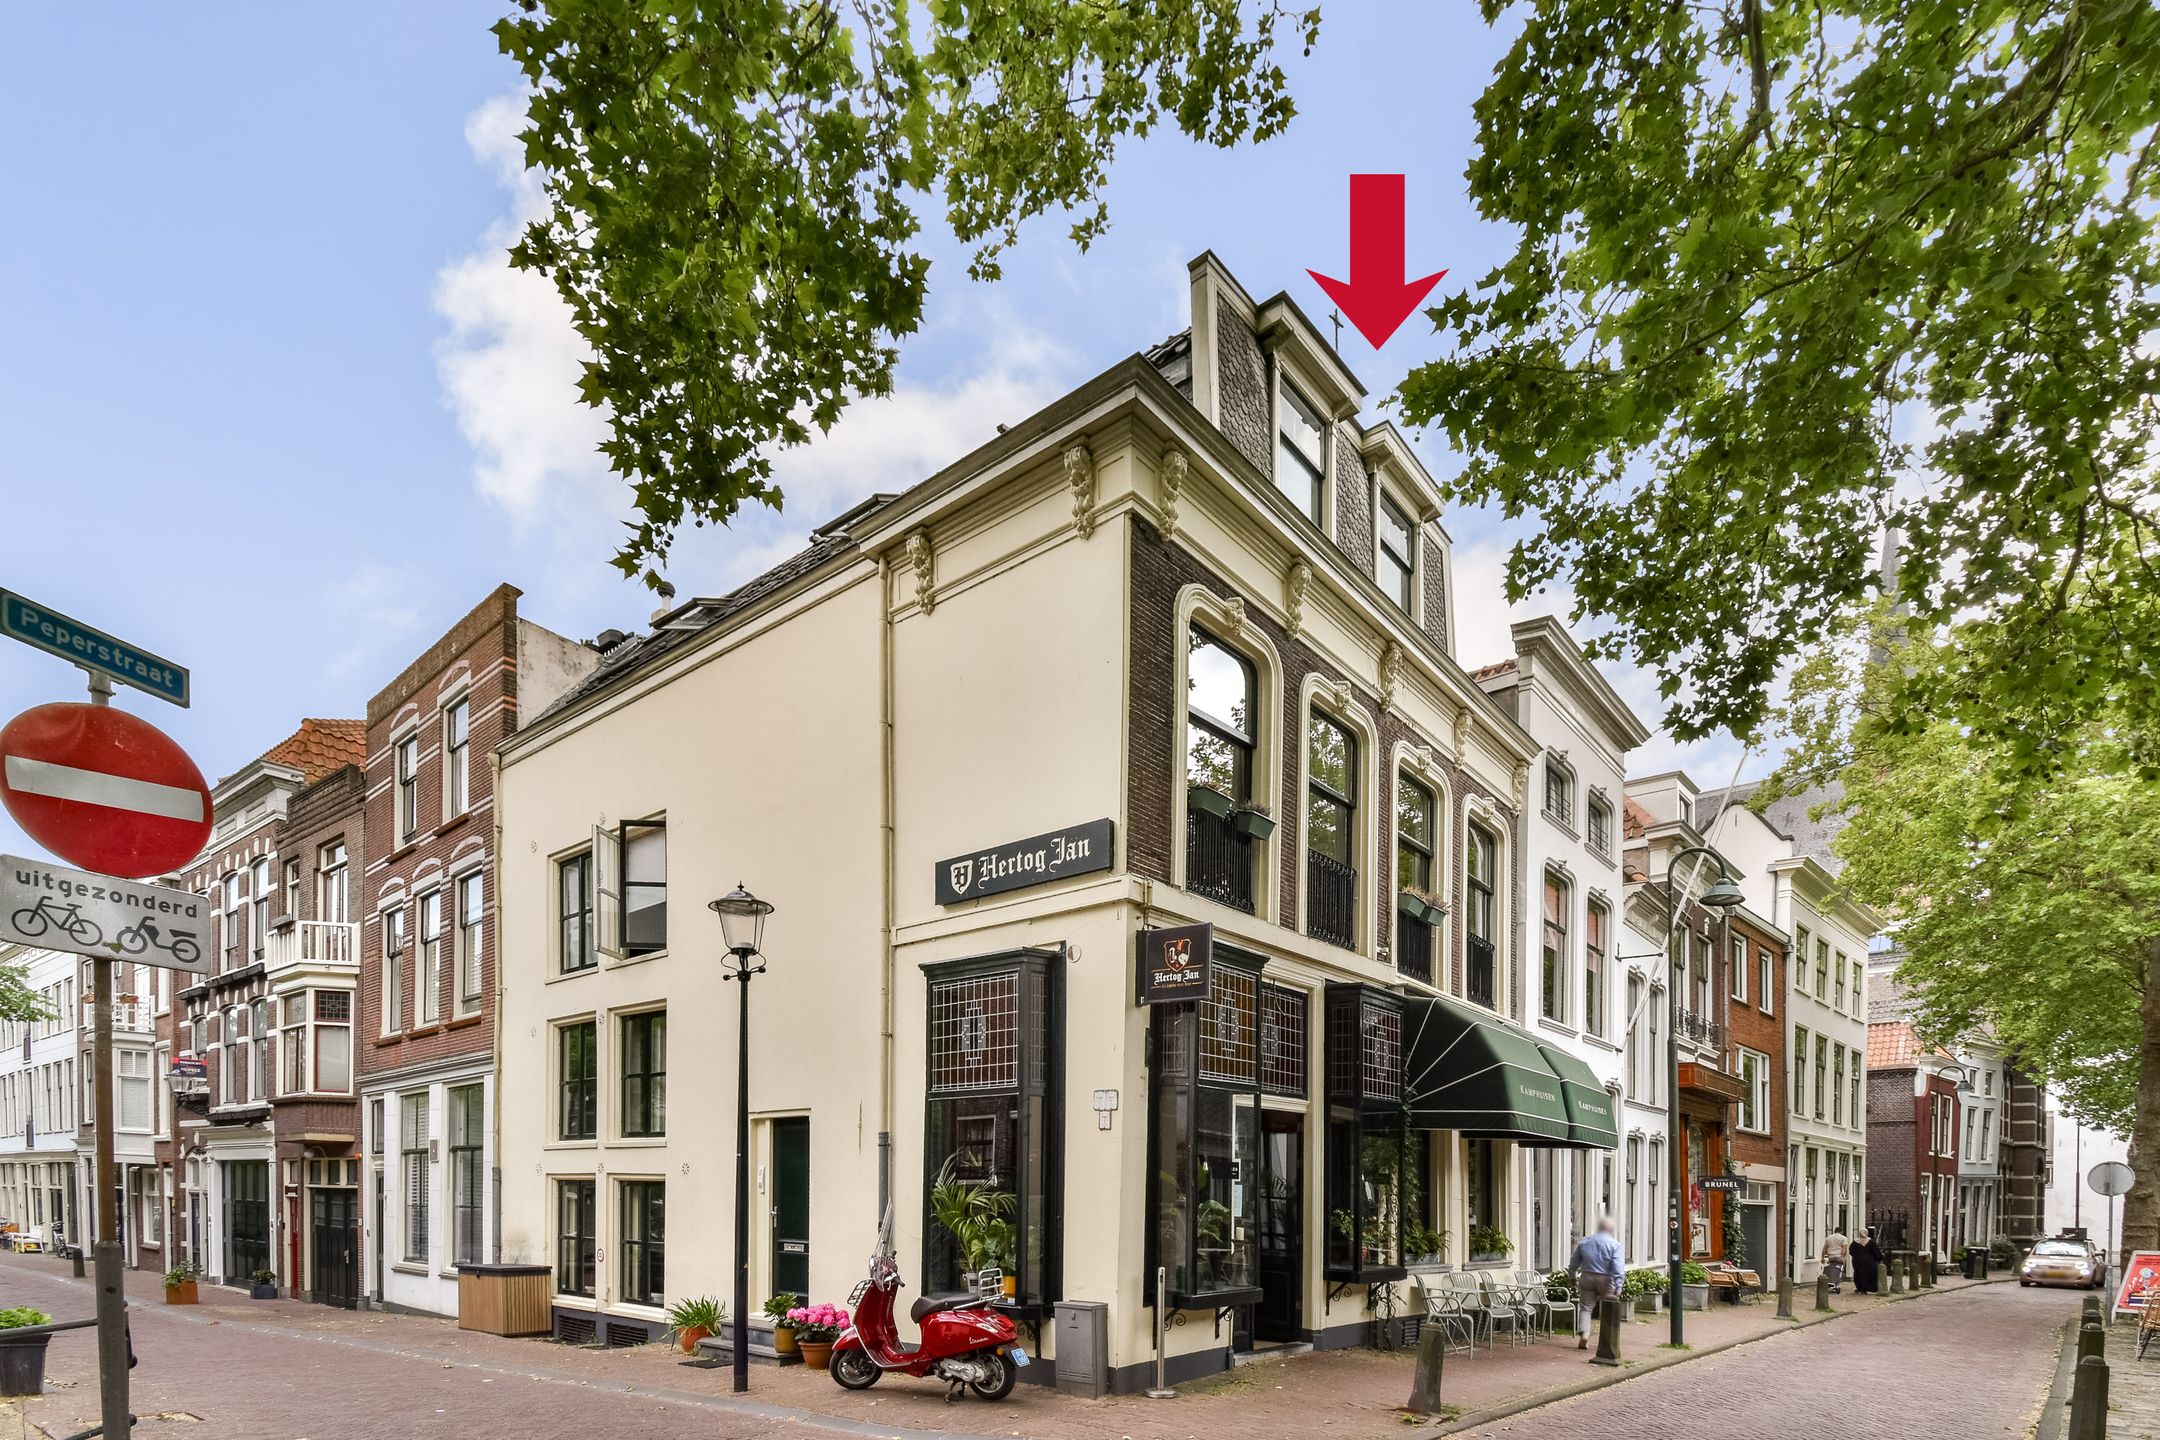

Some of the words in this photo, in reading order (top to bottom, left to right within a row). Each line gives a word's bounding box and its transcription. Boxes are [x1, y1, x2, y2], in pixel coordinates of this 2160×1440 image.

[20, 607, 173, 688] Peperstraat
[977, 853, 1047, 889] Hertog
[1049, 836, 1091, 873] Jan
[15, 869, 198, 919] uitgezonderd
[1153, 972, 1182, 986] Hertog
[1182, 969, 1200, 983] Jan
[1519, 1083, 1556, 1102] KAMPHUISEN
